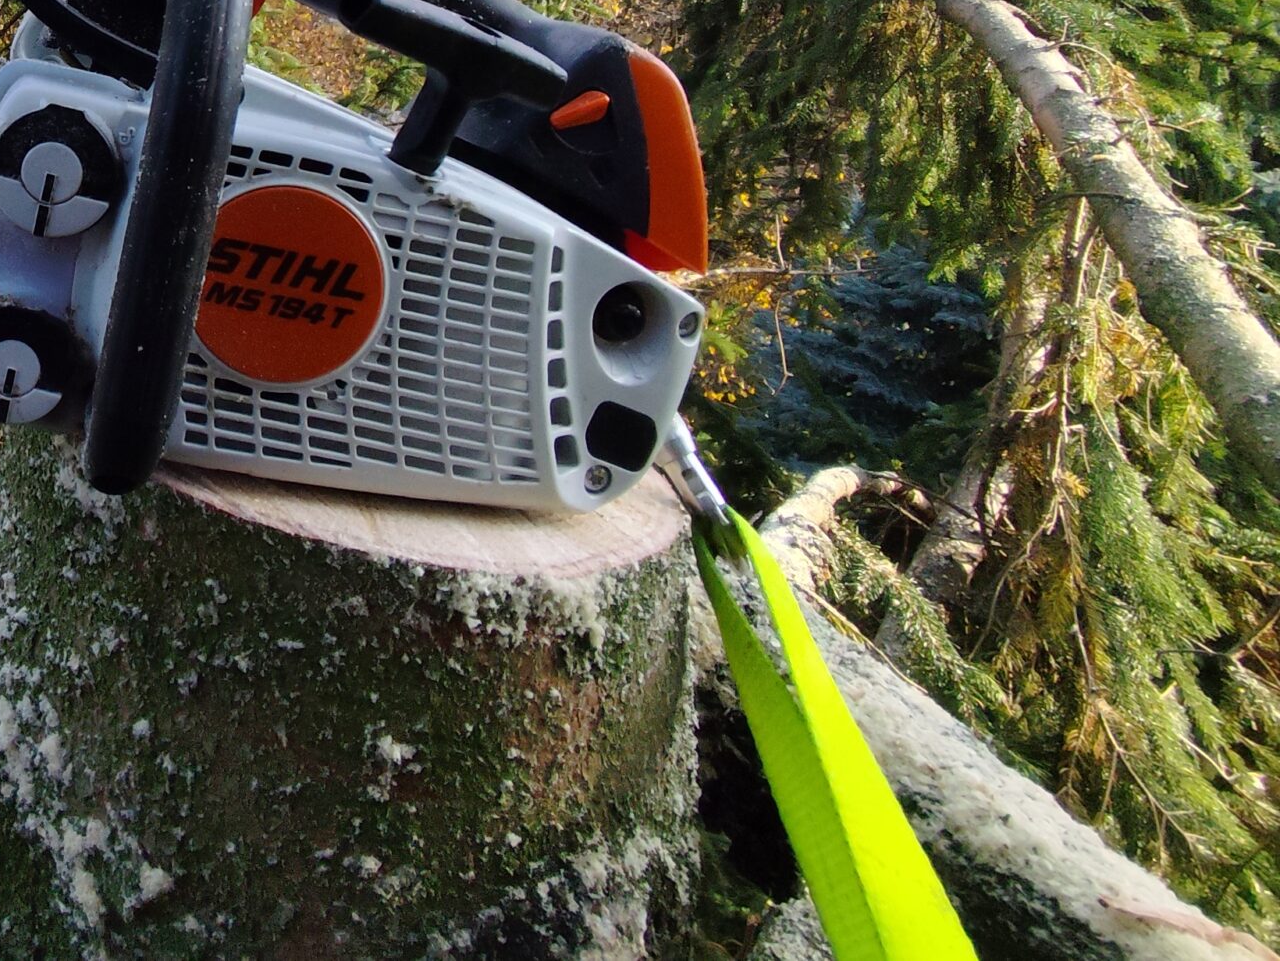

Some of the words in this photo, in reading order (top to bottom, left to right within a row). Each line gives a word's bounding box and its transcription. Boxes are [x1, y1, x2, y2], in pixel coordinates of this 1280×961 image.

[207, 238, 365, 301] STIHL
[205, 282, 265, 312] MS
[268, 294, 325, 325] 194
[331, 306, 355, 329] T
